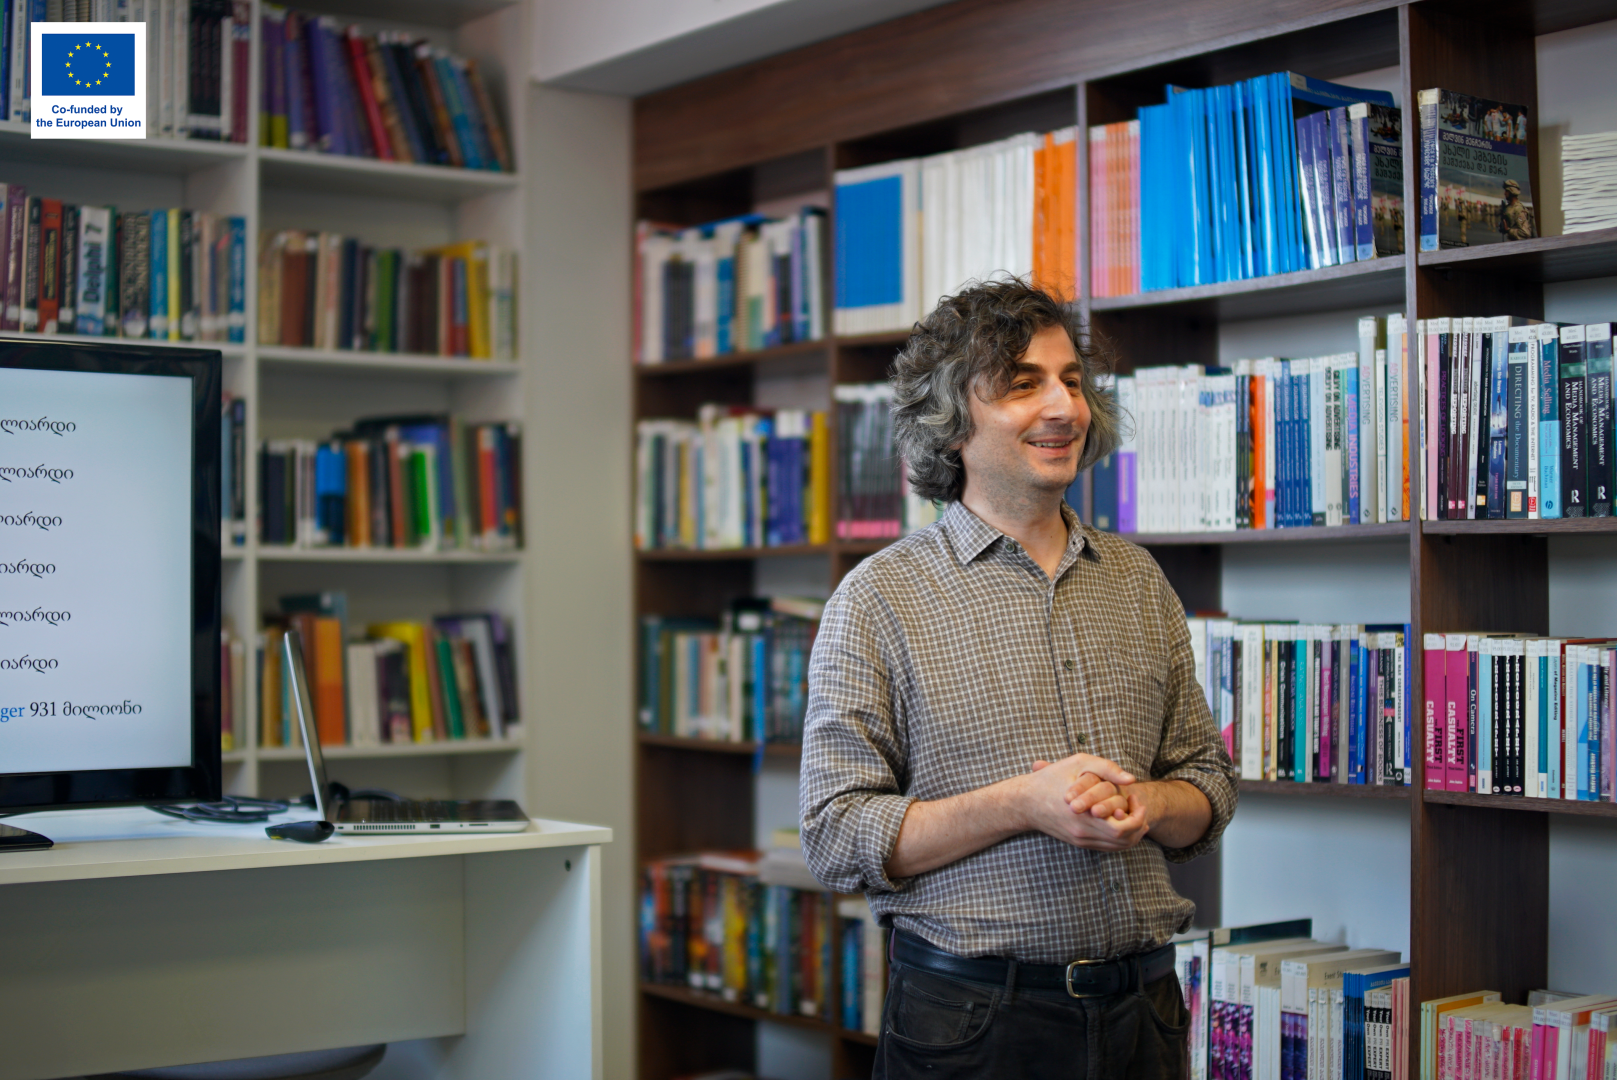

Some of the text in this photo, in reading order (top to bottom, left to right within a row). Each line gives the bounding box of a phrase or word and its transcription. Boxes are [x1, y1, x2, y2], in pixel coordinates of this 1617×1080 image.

[1442, 143, 1508, 166] ახალი ამბების
[1476, 162, 1486, 173] და
[82, 222, 104, 303] Delphi 7
[1362, 366, 1370, 425] ADVERTISING
[1389, 362, 1398, 422] ADVERTISING
[1543, 360, 1552, 414] Media Selling
[0, 416, 76, 436] ლიარდი
[1440, 412, 1447, 422] OF
[1513, 366, 1522, 479] DIRECTING the Documentary
[1591, 377, 1599, 445] AND ECONOMICS
[1598, 377, 1606, 465] MEDIA MANAGEMENT
[1349, 394, 1358, 499] MEDIA INDUSTRIES
[0, 655, 58, 674] იარდი
[0, 700, 142, 722] ger 931 მილიონი
[1470, 689, 1476, 701] On
[1378, 741, 1383, 751] OF
[1426, 700, 1434, 764] CASUALTY
[1434, 727, 1442, 764] FIRST
[1448, 701, 1456, 765] CASUALTY
[1324, 971, 1336, 981] Event
